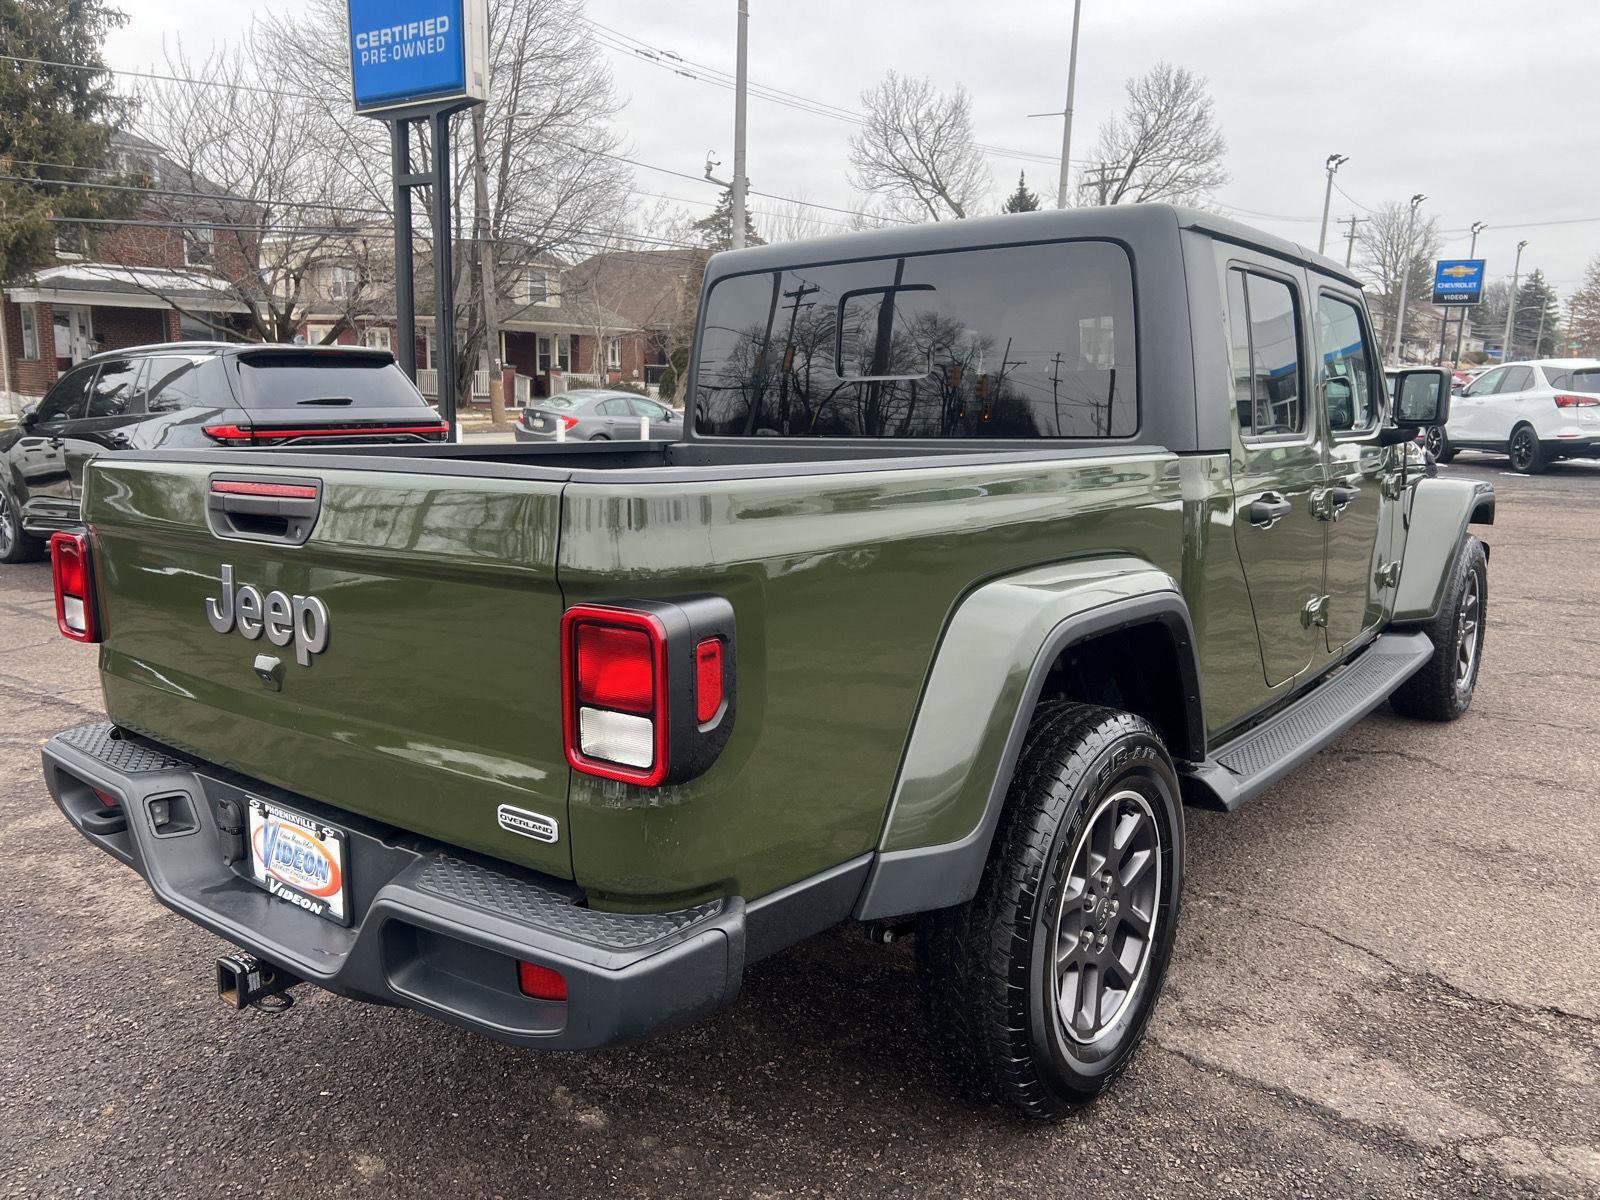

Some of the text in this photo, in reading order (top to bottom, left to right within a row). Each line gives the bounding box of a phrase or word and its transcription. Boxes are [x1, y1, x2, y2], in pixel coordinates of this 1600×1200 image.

[356, 16, 450, 50] CERTIFIED
[361, 36, 445, 67] PRE-OWNED
[206, 564, 328, 667] Jeep
[264, 803, 317, 831] PHOENIXVILLE
[500, 813, 553, 835] OVERLAND
[263, 819, 329, 883] VIDEON
[269, 878, 323, 915] VIDEON
